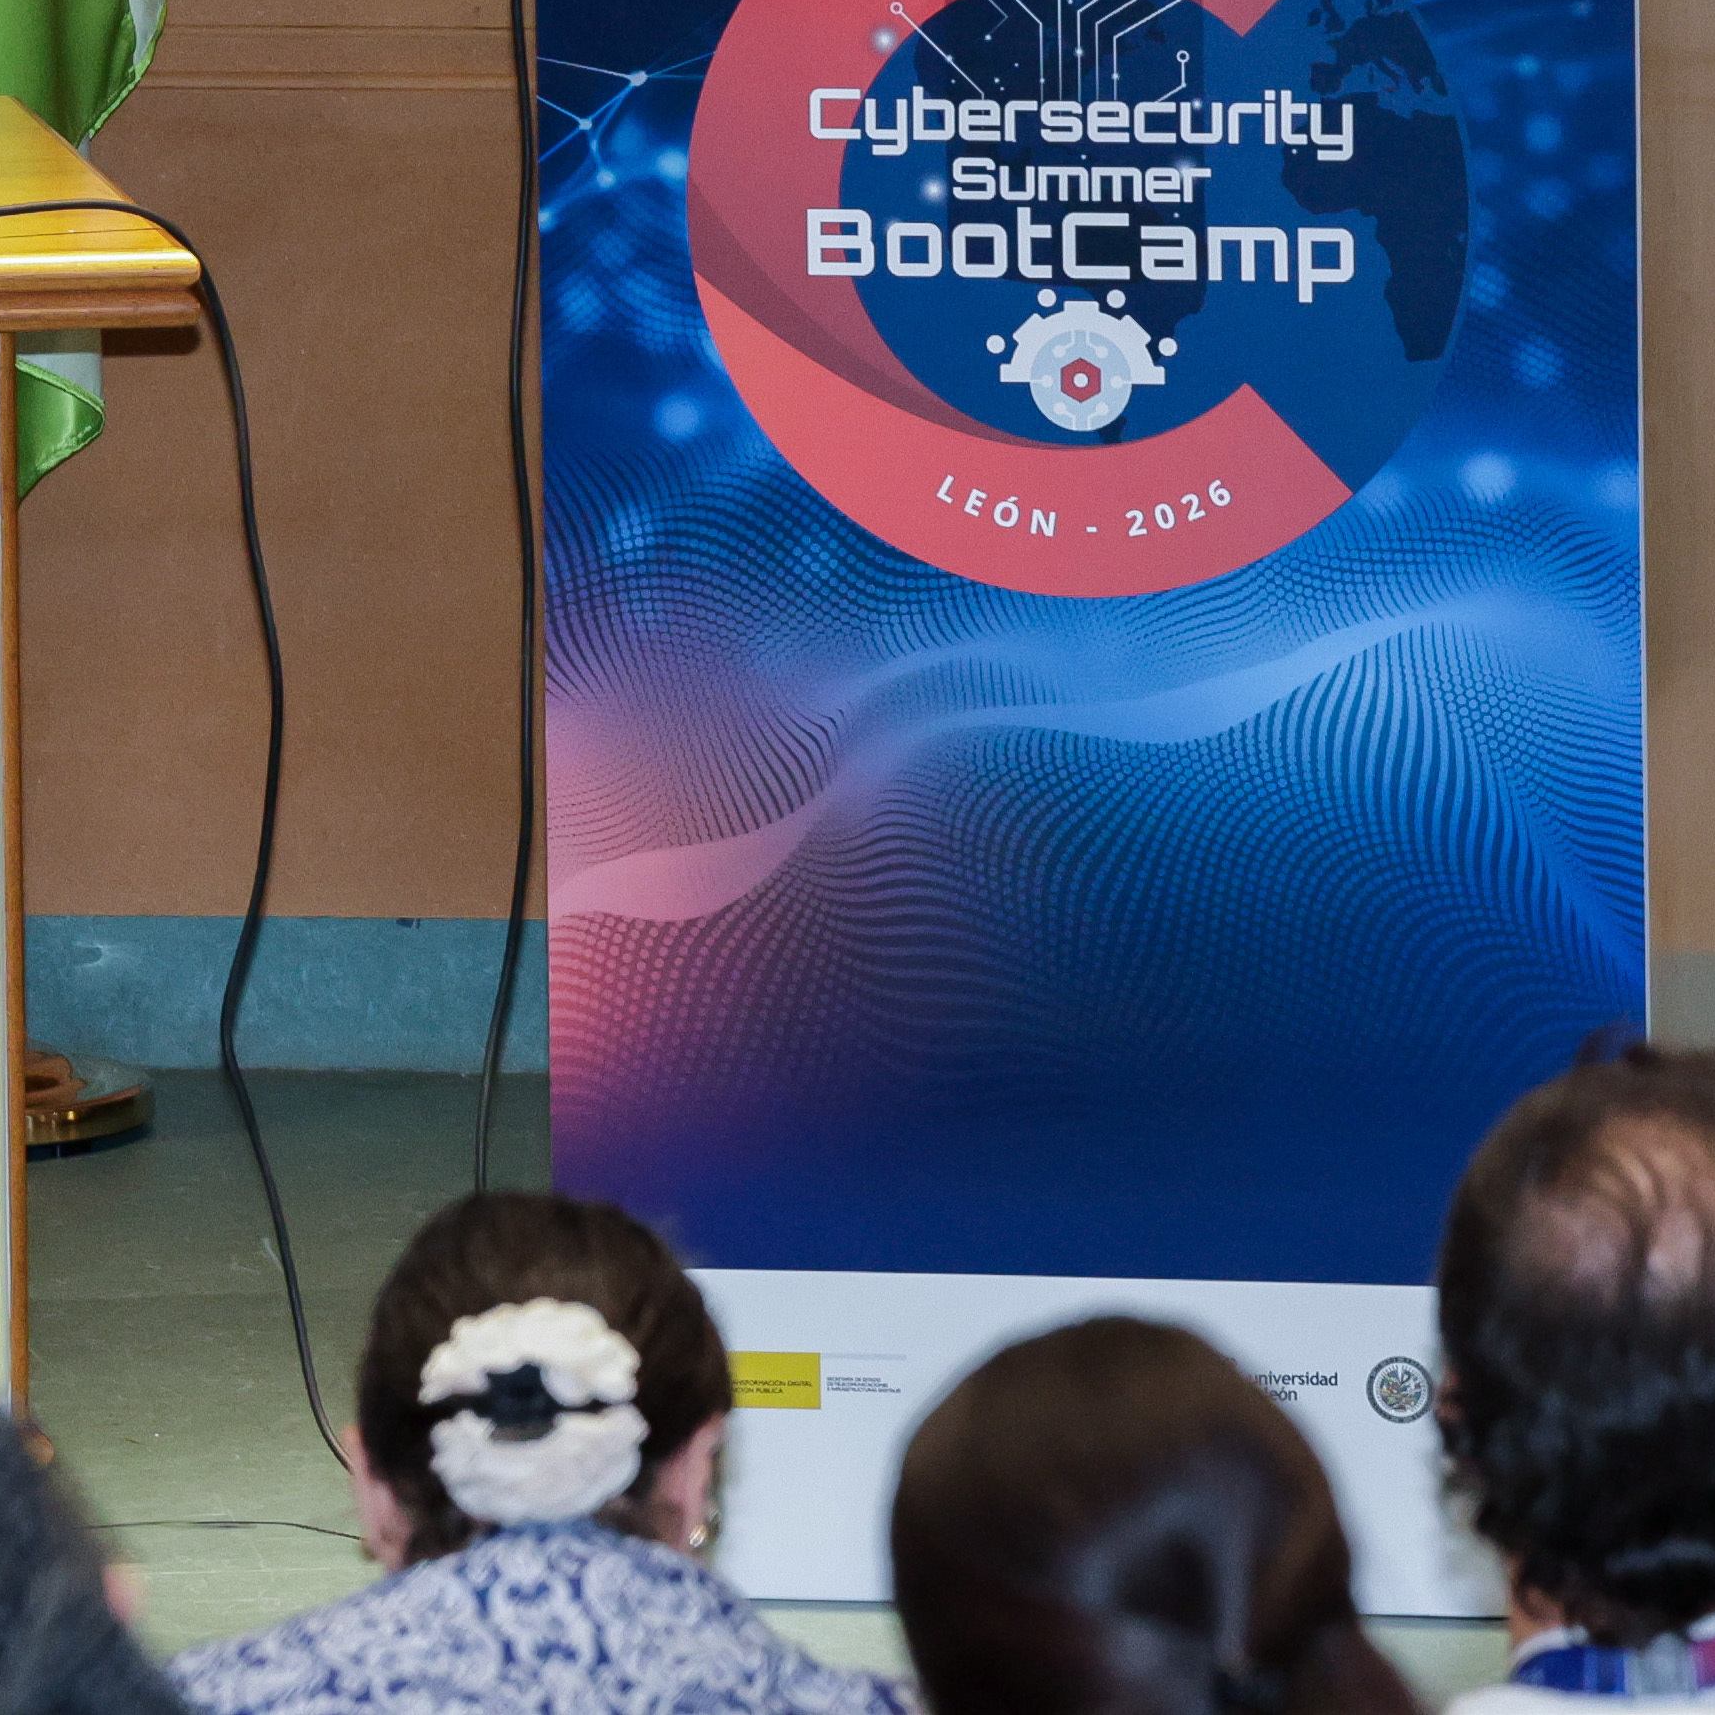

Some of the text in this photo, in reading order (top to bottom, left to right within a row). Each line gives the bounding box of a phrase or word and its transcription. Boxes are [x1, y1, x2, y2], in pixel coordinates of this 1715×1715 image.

[808, 86, 1355, 162] Cybersecurity
[952, 156, 1212, 204] Summer
[805, 206, 1355, 304] BootCamp
[935, 474, 1057, 537] LEÓN
[1123, 479, 1233, 537] 2026
